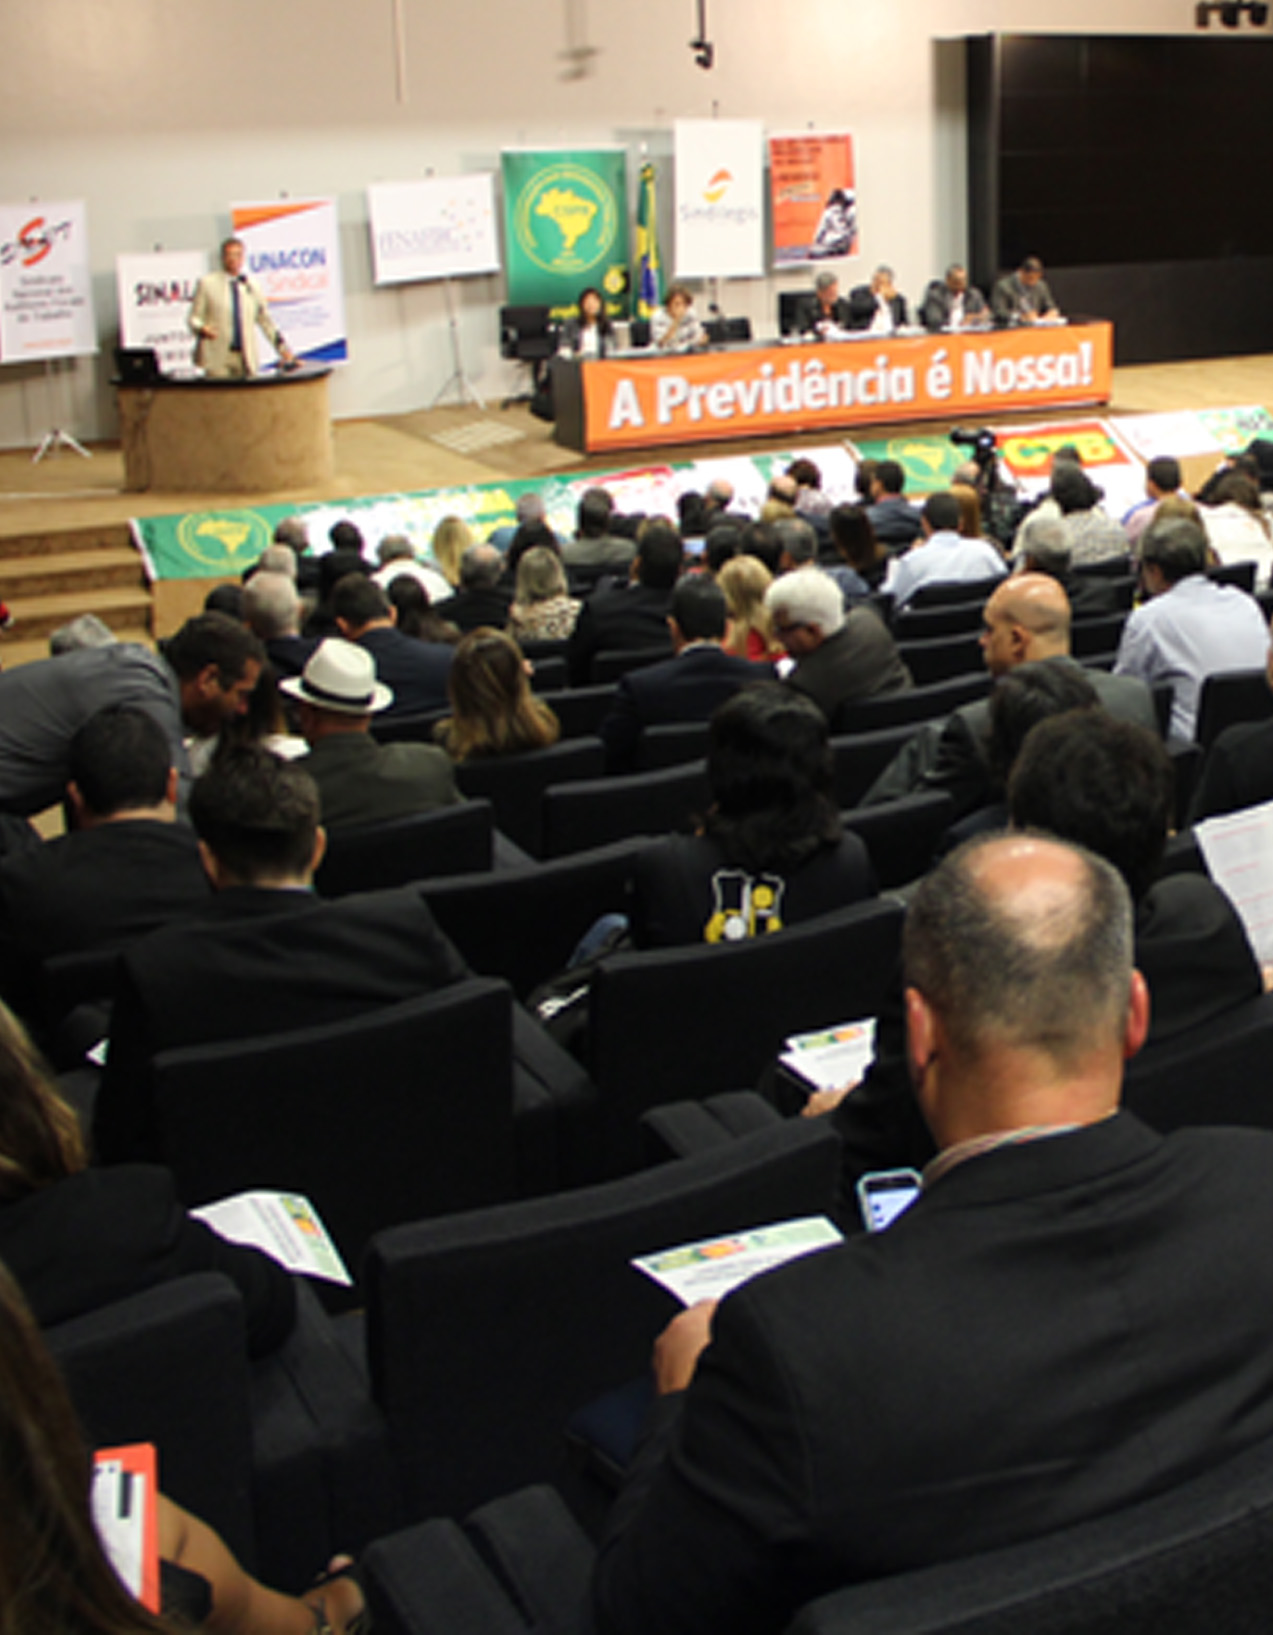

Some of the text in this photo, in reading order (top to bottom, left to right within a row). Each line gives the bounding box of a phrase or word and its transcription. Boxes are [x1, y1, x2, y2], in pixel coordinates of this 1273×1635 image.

[248, 247, 327, 273] UNACON
[608, 341, 1093, 429] A Previdência é Nossa!
